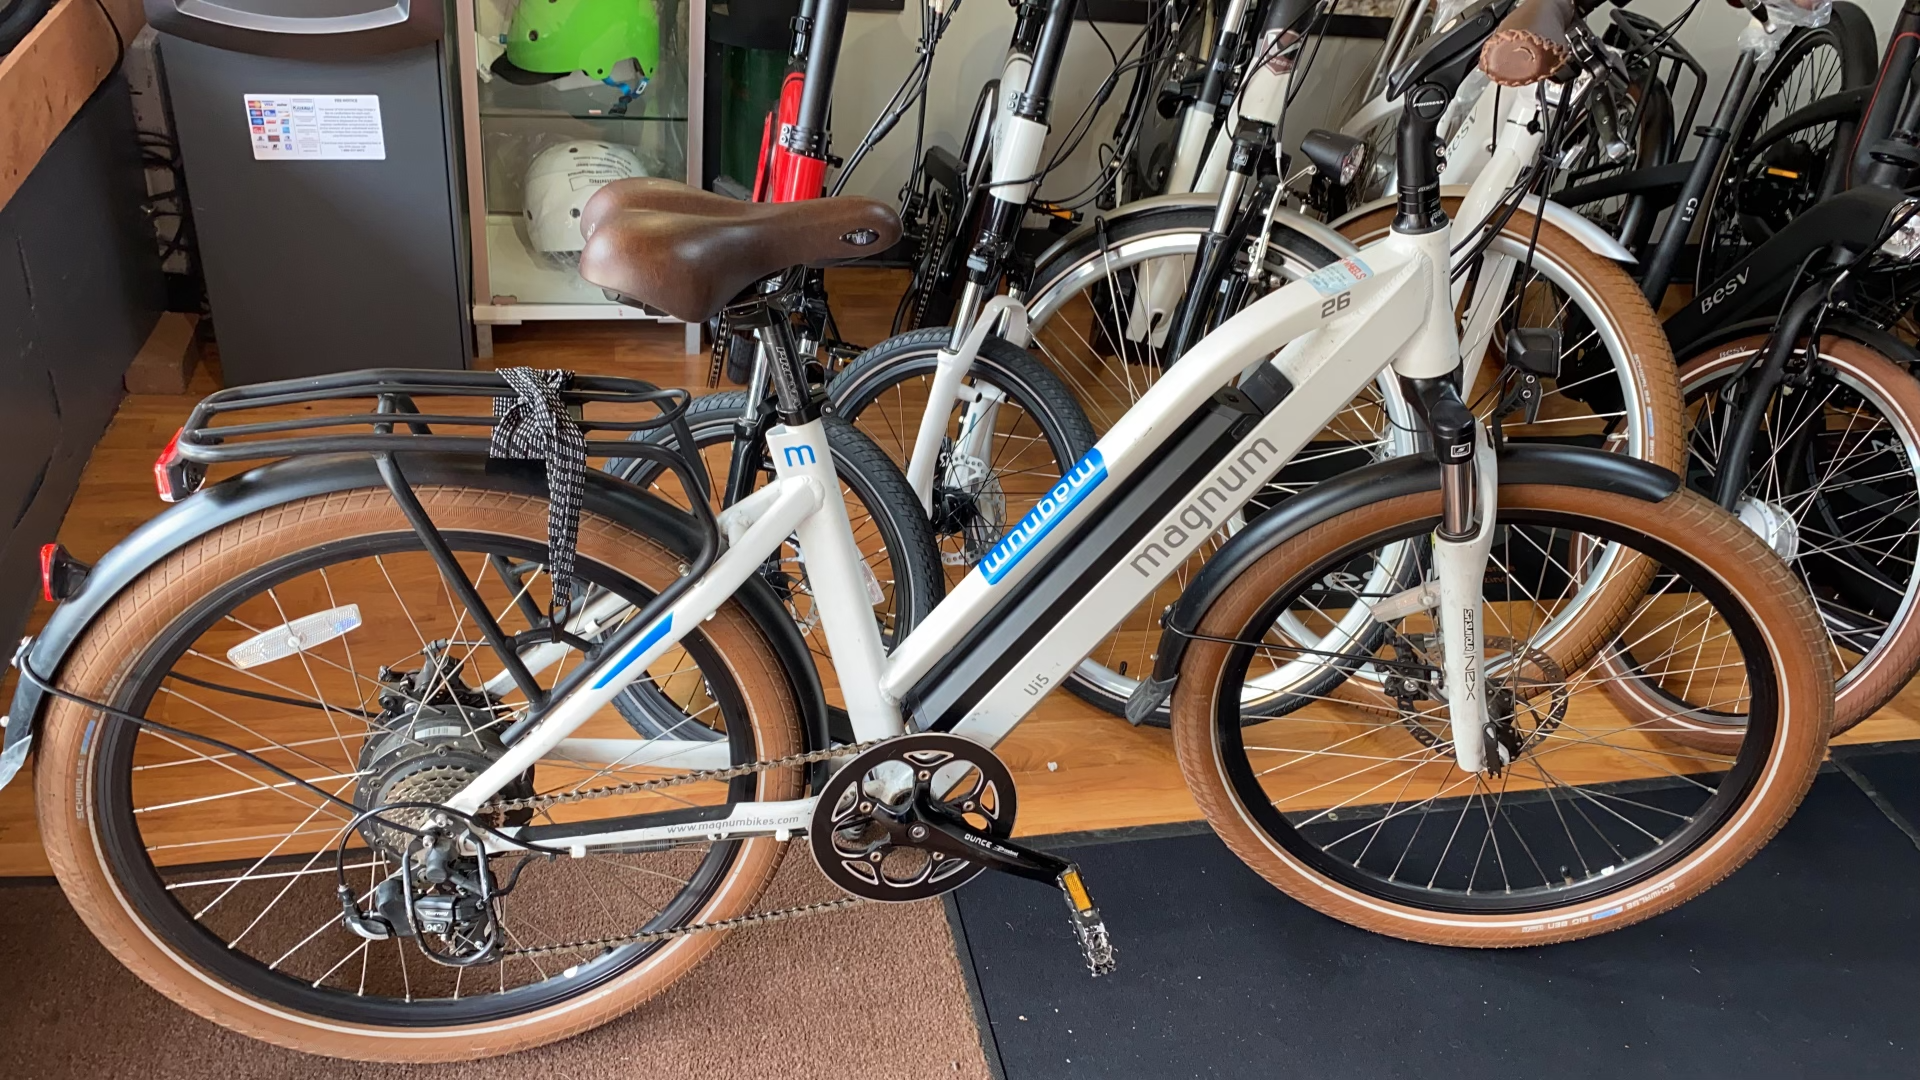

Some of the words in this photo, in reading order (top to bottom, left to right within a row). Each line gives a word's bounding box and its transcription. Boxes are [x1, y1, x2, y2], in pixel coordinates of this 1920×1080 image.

[1681, 197, 1698, 223] CF1
[1321, 291, 1351, 319] 26
[783, 444, 817, 467] m
[983, 457, 1096, 575] magnum
[1129, 437, 1279, 578] magnum
[1023, 673, 1050, 696] Ui5
[1464, 655, 1476, 701] NEX
[75, 758, 86, 820] SCHWALBE
[667, 816, 799, 834] www.magnumbikes.com
[1625, 882, 1677, 910] SCHWALBE
[1571, 916, 1589, 926] BIG
